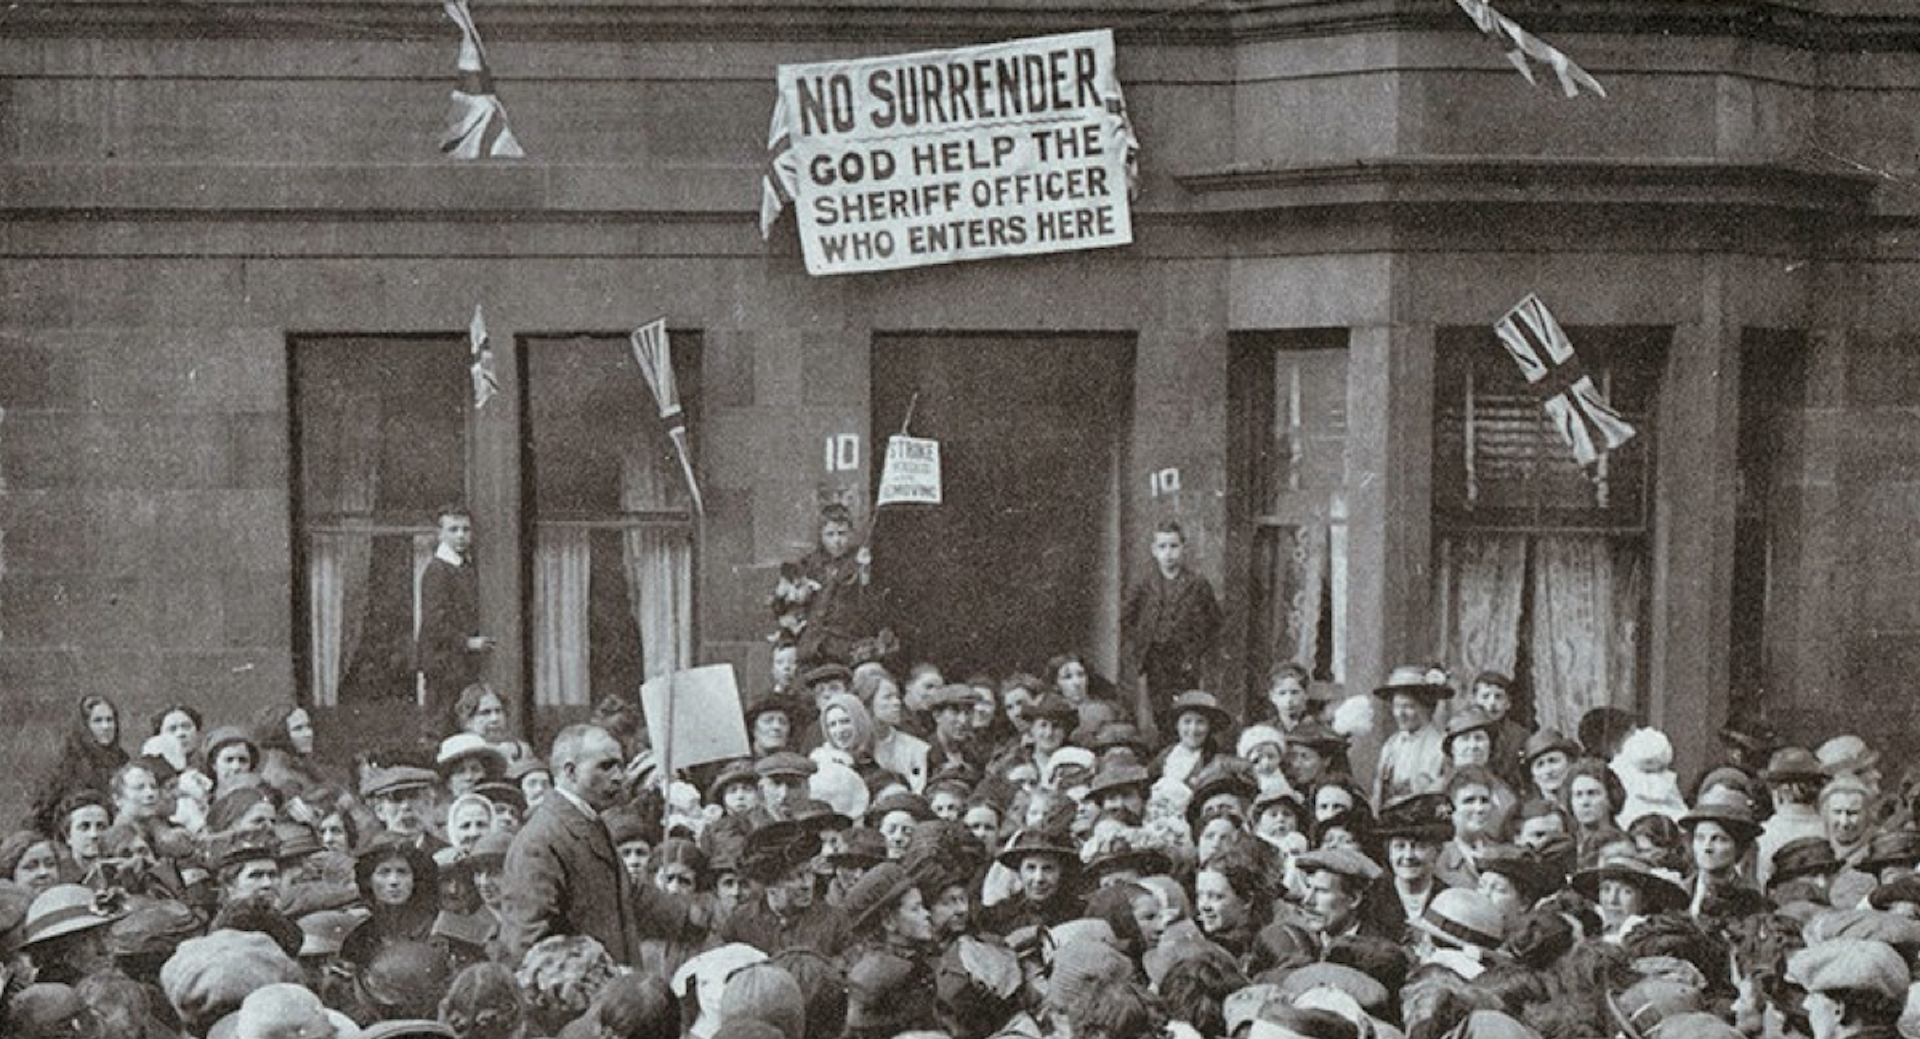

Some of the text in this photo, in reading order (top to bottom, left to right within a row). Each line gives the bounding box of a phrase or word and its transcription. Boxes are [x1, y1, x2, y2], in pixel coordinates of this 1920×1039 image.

[796, 48, 1101, 136] NO SURRENDER
[810, 124, 1102, 185] GOD HELP THE
[815, 167, 1111, 226] SHERIFF OFFICER
[819, 206, 1115, 264] WHO ENTERS HERE
[825, 433, 860, 472] 10
[1151, 468, 1180, 497] 10
